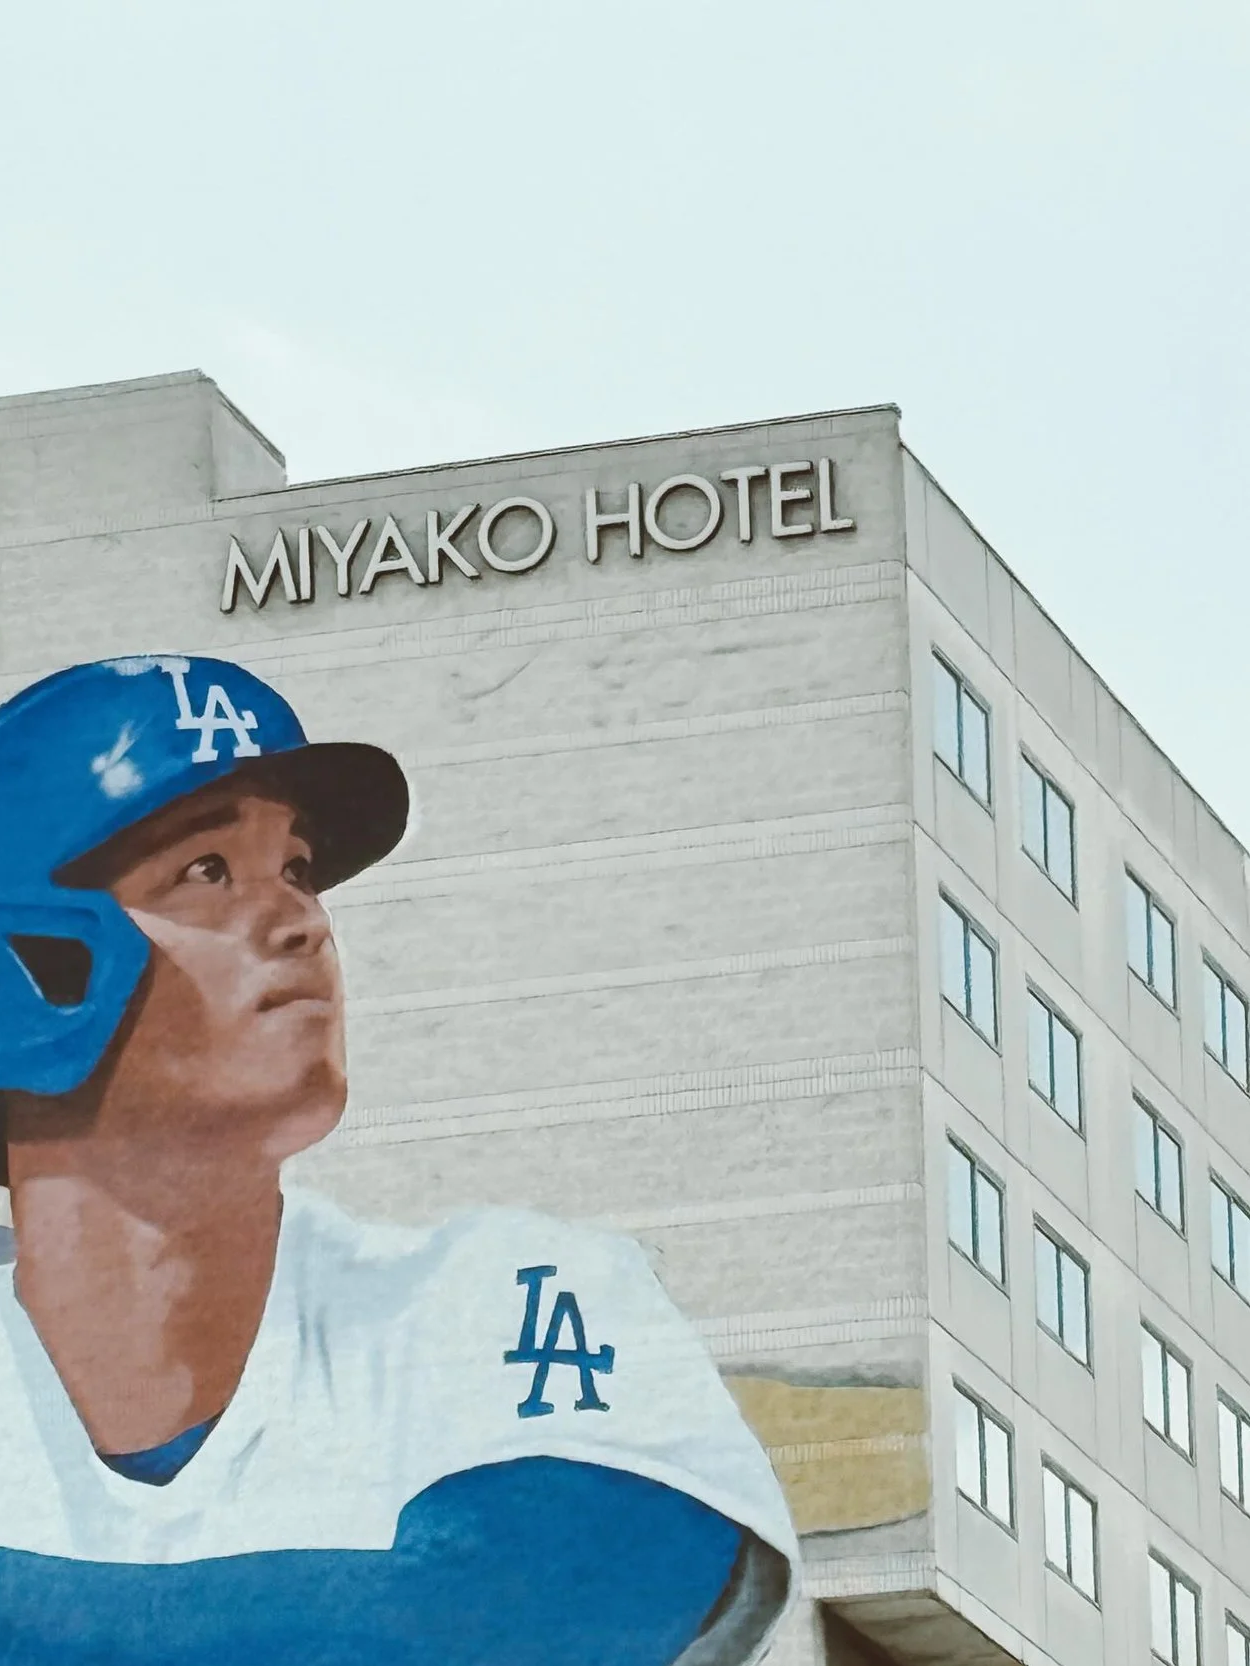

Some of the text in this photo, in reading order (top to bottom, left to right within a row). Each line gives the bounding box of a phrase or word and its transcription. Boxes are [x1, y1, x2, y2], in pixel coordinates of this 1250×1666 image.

[220, 457, 854, 614] MIYAKO HOTEL
[161, 656, 261, 763] LA
[504, 1265, 615, 1418] LA
